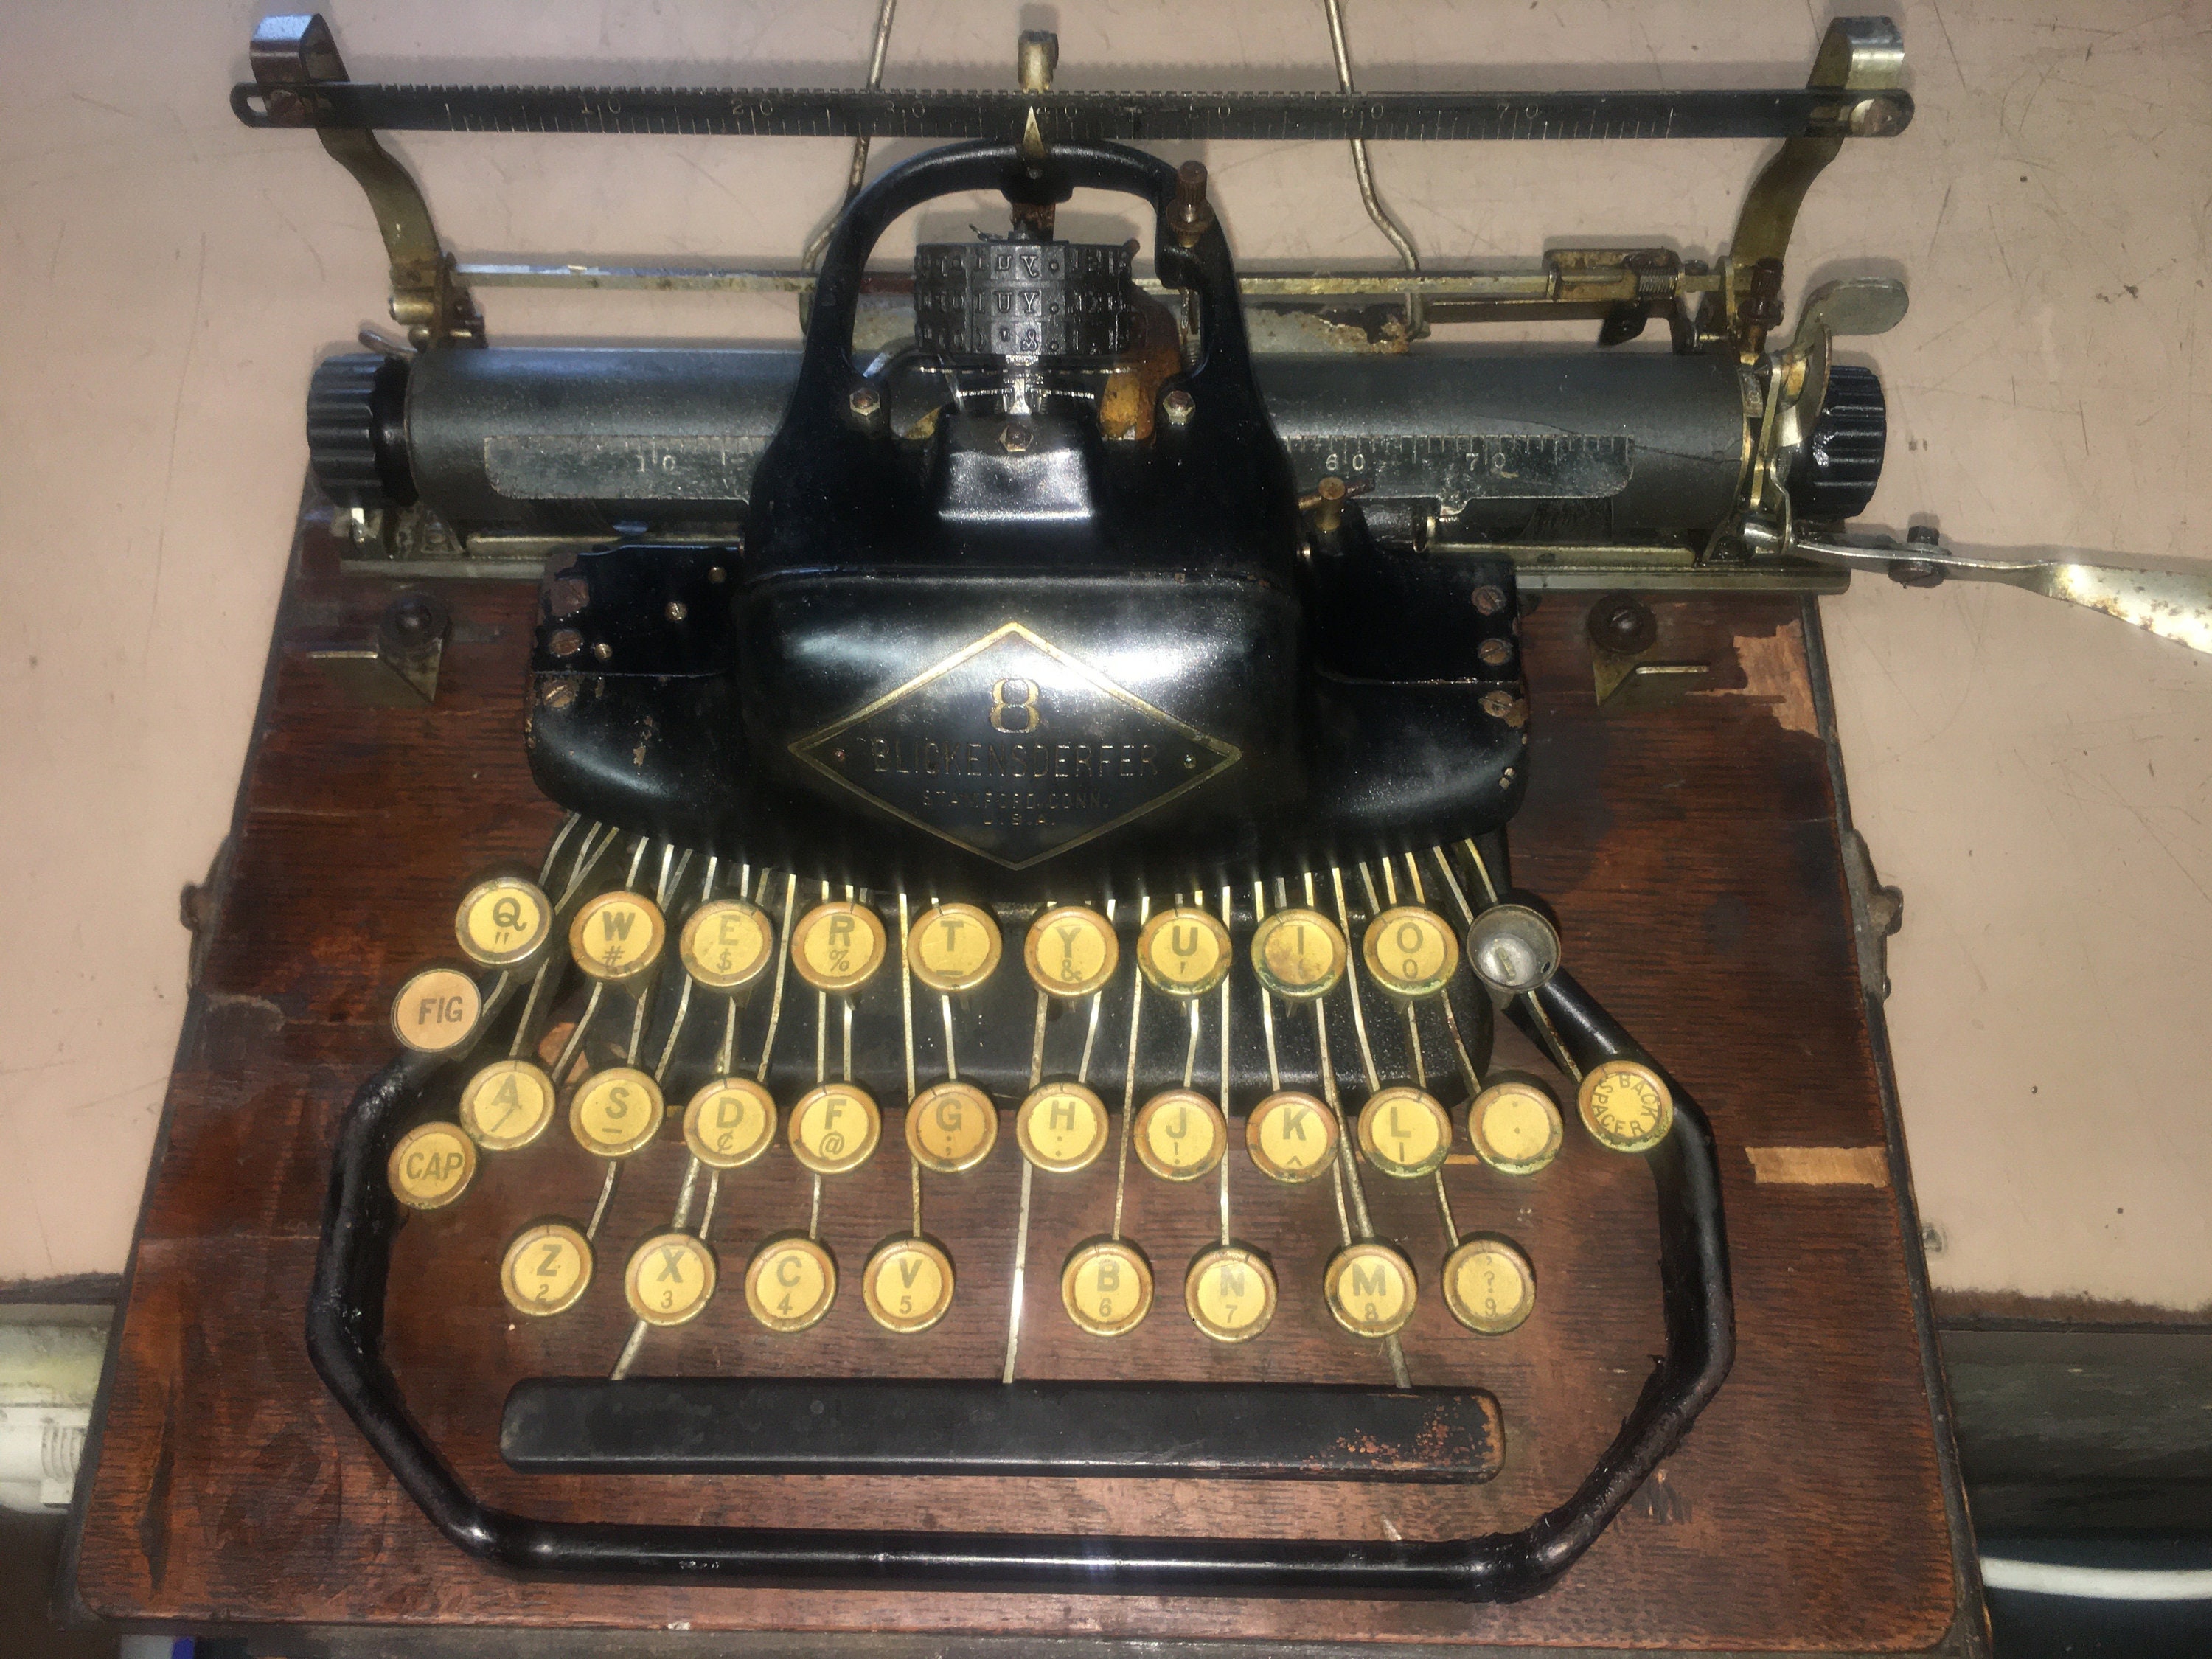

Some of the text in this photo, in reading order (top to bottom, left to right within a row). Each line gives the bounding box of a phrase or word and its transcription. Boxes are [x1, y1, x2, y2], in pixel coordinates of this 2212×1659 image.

[989, 678, 1042, 734] 8
[871, 738, 1158, 778] BLICKENSDERFER
[493, 897, 527, 932] Q
[602, 911, 636, 942] W
[717, 917, 740, 946] E
[827, 915, 855, 947] R
[940, 920, 964, 952] T
[1056, 927, 1082, 959] Y
[1172, 925, 1199, 956] U
[1298, 925, 1304, 956] I
[1396, 922, 1423, 955] O
[716, 947, 733, 972] $
[829, 950, 850, 973] %
[1060, 959, 1082, 982] &
[418, 995, 463, 1026] FIG
[490, 1075, 518, 1107] A
[605, 1088, 628, 1119] S
[1619, 1074, 1658, 1122] BACK
[716, 1097, 743, 1128] D
[824, 1099, 846, 1130] F
[936, 1099, 962, 1132] G
[1049, 1100, 1076, 1131] H
[1165, 1107, 1187, 1139] J
[1390, 1106, 1412, 1138] L
[1592, 1079, 1646, 1137] SPACER
[1282, 1107, 1311, 1141] K
[819, 1131, 845, 1156] @
[406, 1152, 463, 1180] CAP
[535, 1244, 563, 1277] Z
[657, 1250, 686, 1283] X
[776, 1256, 803, 1288] C
[899, 1259, 923, 1289] V
[1096, 1261, 1120, 1293] B
[1220, 1265, 1245, 1297] N
[1352, 1264, 1386, 1296] M
[1484, 1270, 1495, 1294] ?
[535, 1284, 549, 1302] 2
[661, 1290, 674, 1310] 3
[777, 1294, 793, 1315] 4
[900, 1295, 913, 1315] 5
[1099, 1298, 1113, 1318] 6
[1484, 1298, 1497, 1318] 9
[1225, 1304, 1239, 1324] 7
[1364, 1302, 1378, 1323] 8
